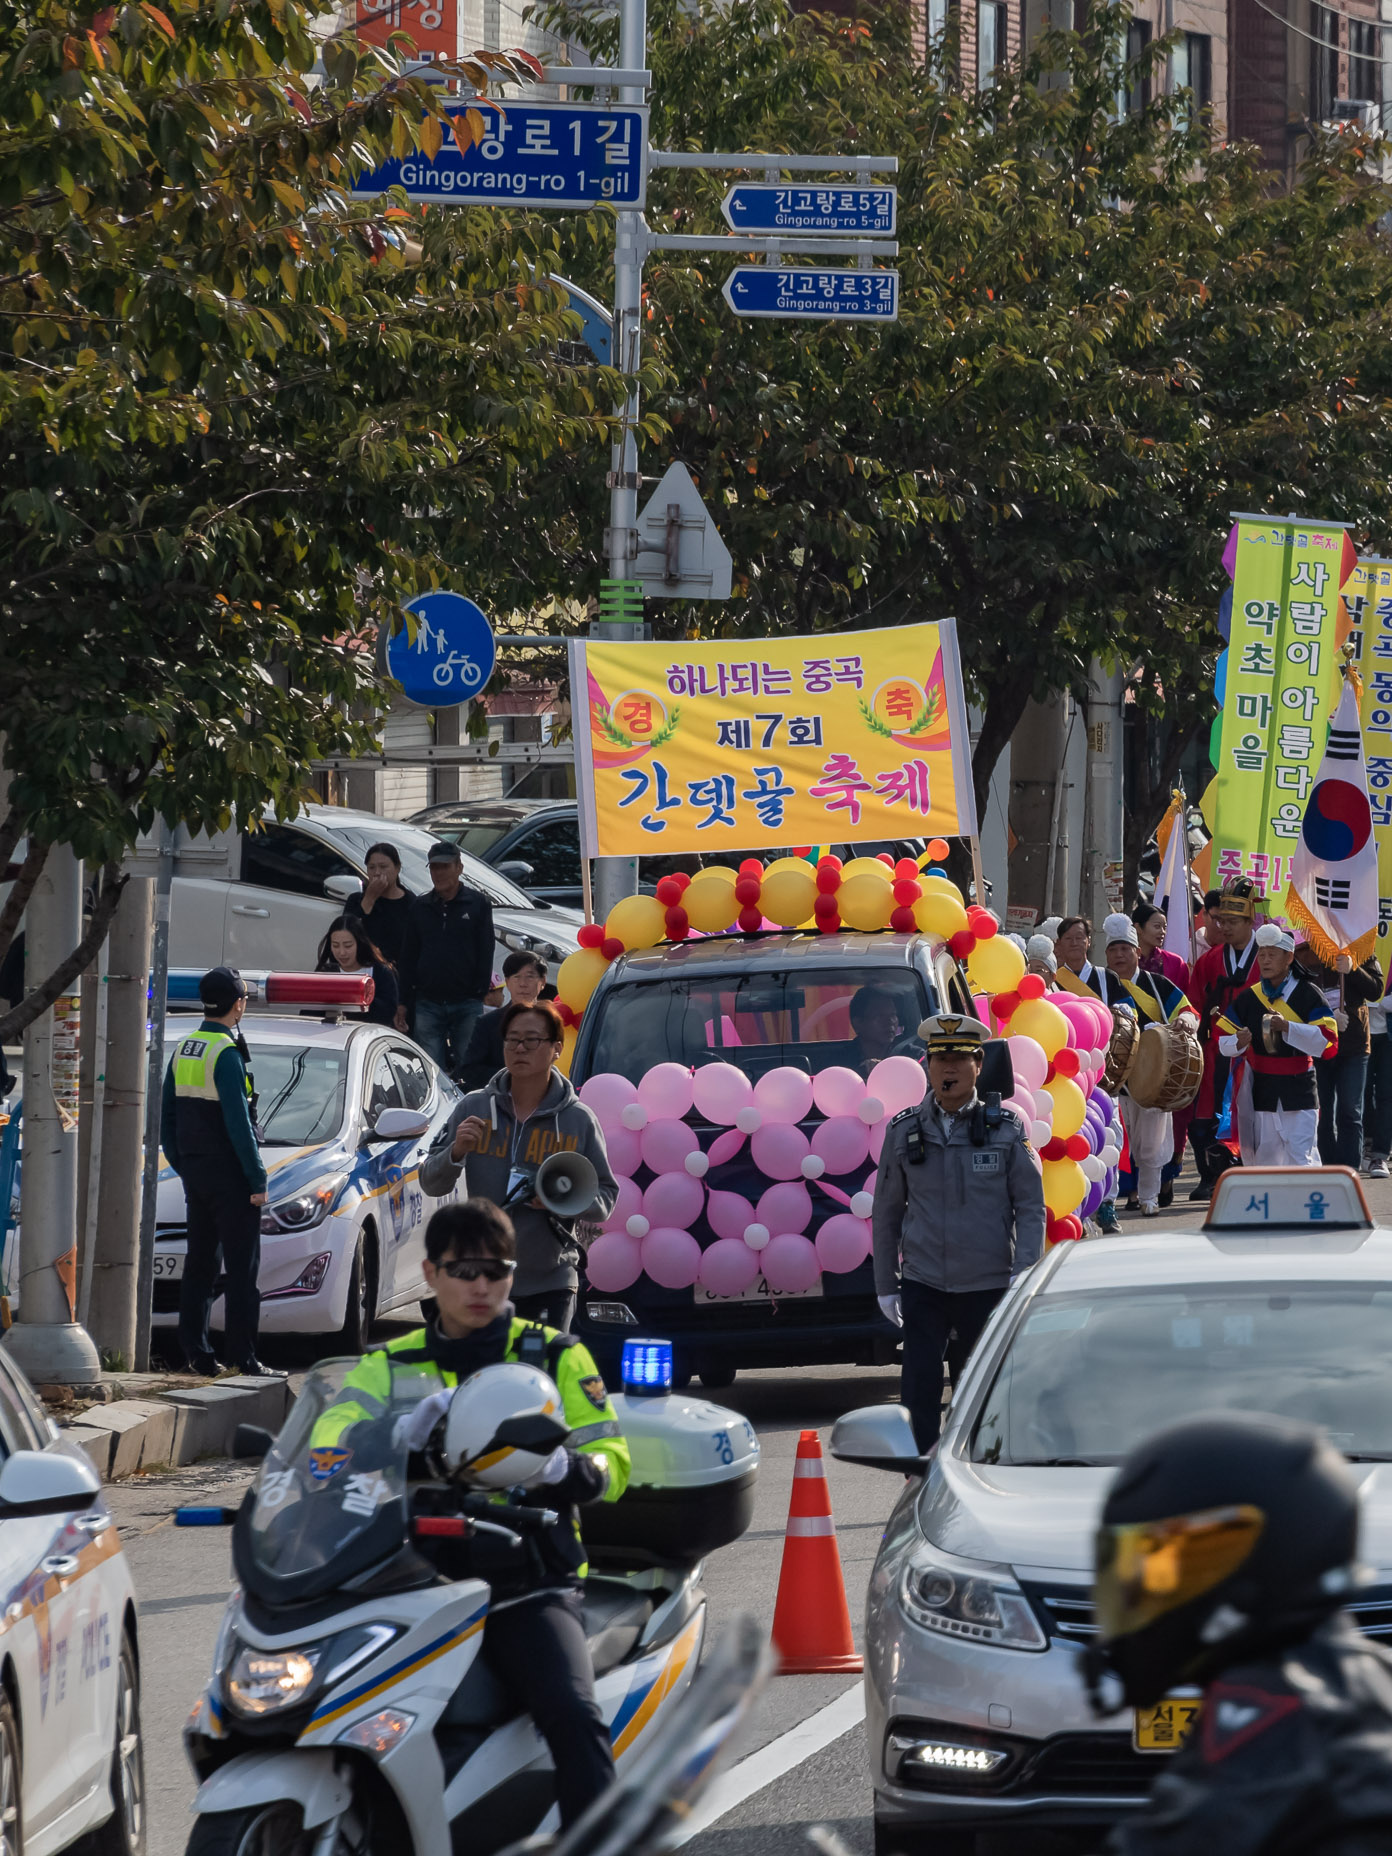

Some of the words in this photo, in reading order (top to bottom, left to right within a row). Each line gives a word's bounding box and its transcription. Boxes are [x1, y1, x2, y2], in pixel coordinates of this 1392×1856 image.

[399, 163, 566, 195] Gingorang-ro
[576, 170, 630, 197] 1-gil
[775, 190, 889, 216] 긴고랑로5길
[775, 213, 857, 228] Gingorang-ro
[861, 215, 889, 229] 5-gil
[777, 274, 892, 300] 긴고랑로3길
[776, 296, 859, 312] Gingorang-ro
[863, 300, 891, 313] 3-gil
[1311, 534, 1339, 550] 축제
[665, 662, 793, 698] 하나되는
[801, 655, 865, 695] 중곡
[622, 701, 654, 735] 경
[885, 687, 914, 721] 축
[716, 712, 824, 750] 제7회
[808, 753, 931, 826] 축제
[1217, 849, 1294, 898] 중곡1
